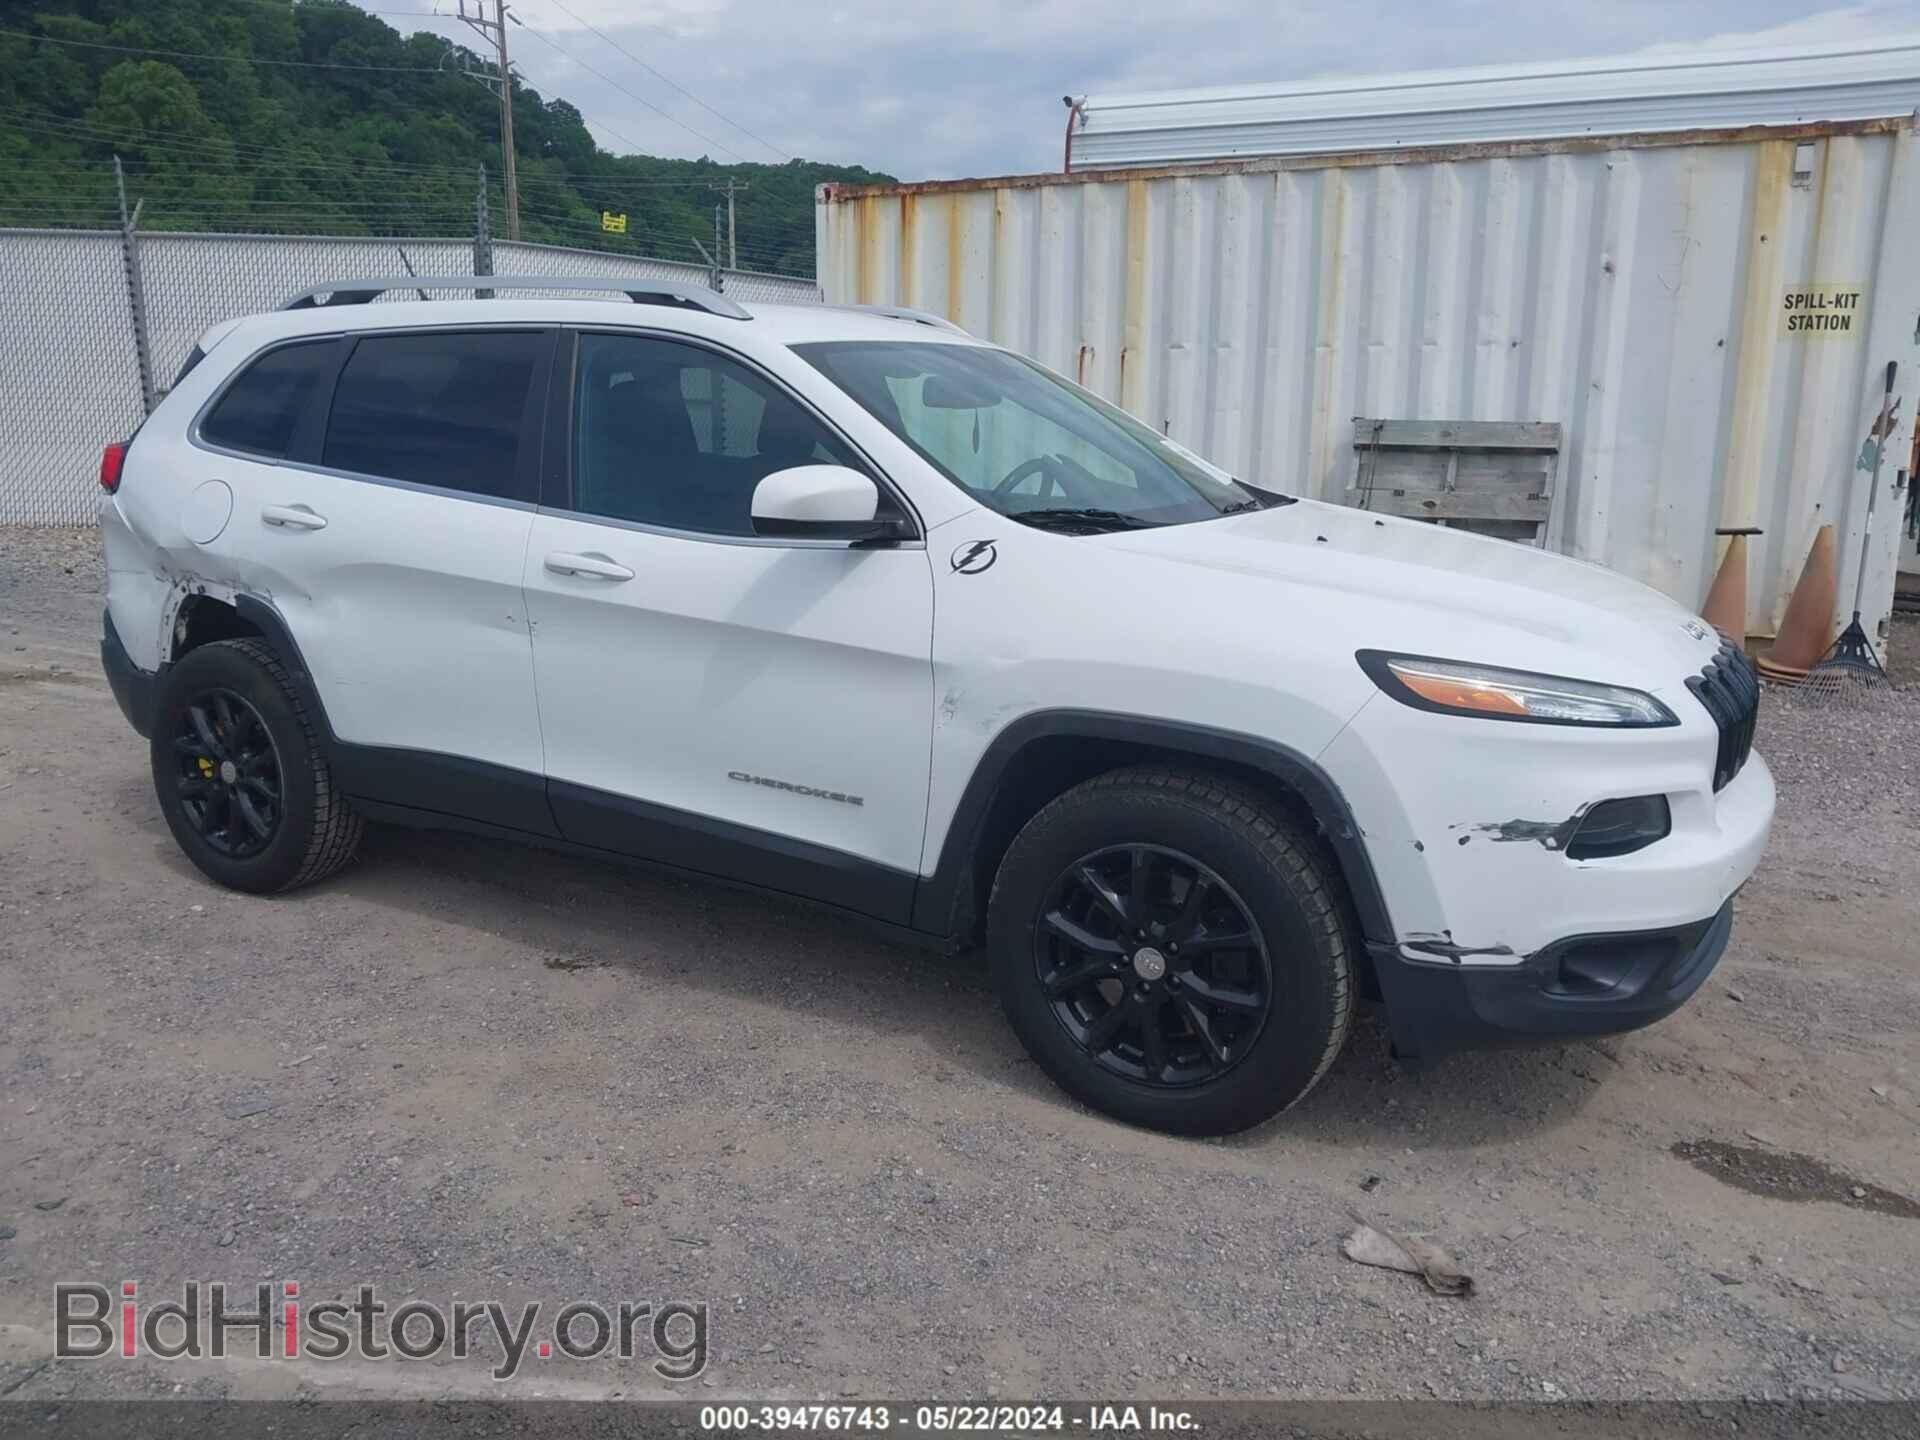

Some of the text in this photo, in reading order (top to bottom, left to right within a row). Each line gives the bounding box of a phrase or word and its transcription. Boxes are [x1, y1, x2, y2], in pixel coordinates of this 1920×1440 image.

[1784, 293, 1860, 310] SPILL-KIT
[1787, 314, 1851, 331] STATION
[728, 771, 864, 806] CHEROKEE
